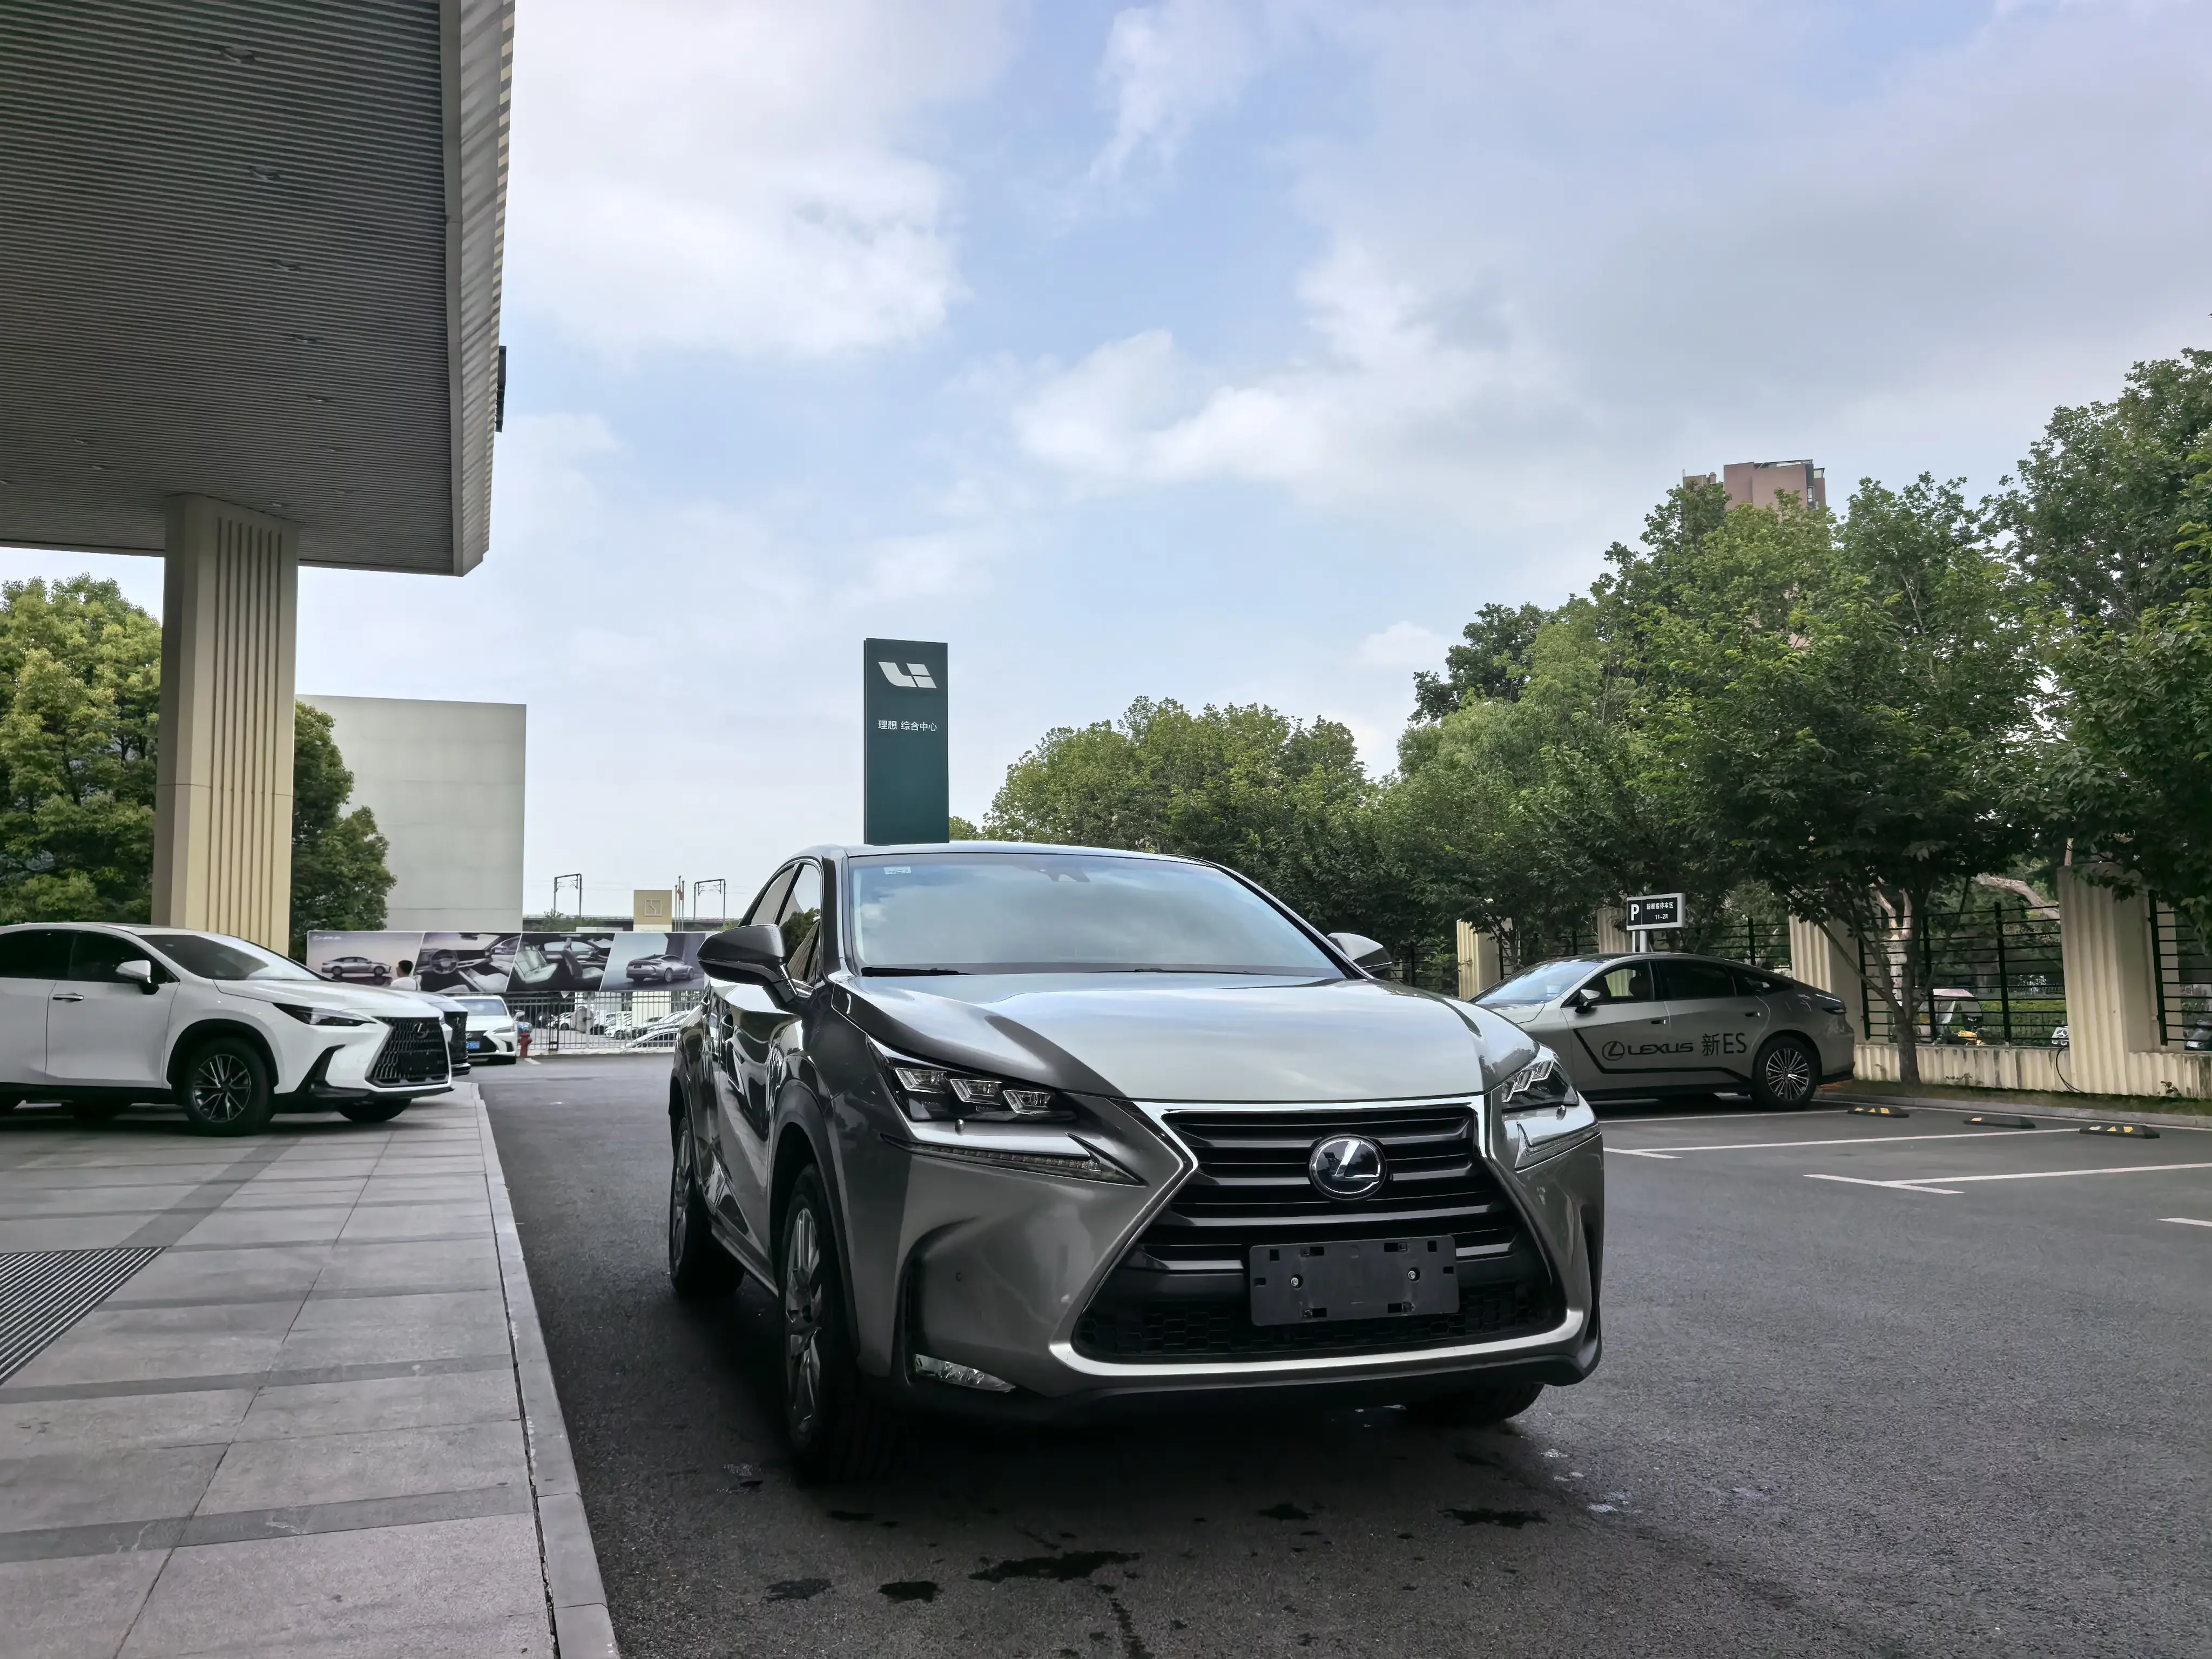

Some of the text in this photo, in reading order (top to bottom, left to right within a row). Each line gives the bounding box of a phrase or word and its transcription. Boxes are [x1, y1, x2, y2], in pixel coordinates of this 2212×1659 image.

[878, 720, 937, 731] 理想 综合中心
[1631, 904, 1639, 921] P
[1628, 1032, 1747, 1056] LEXUS 新ES
